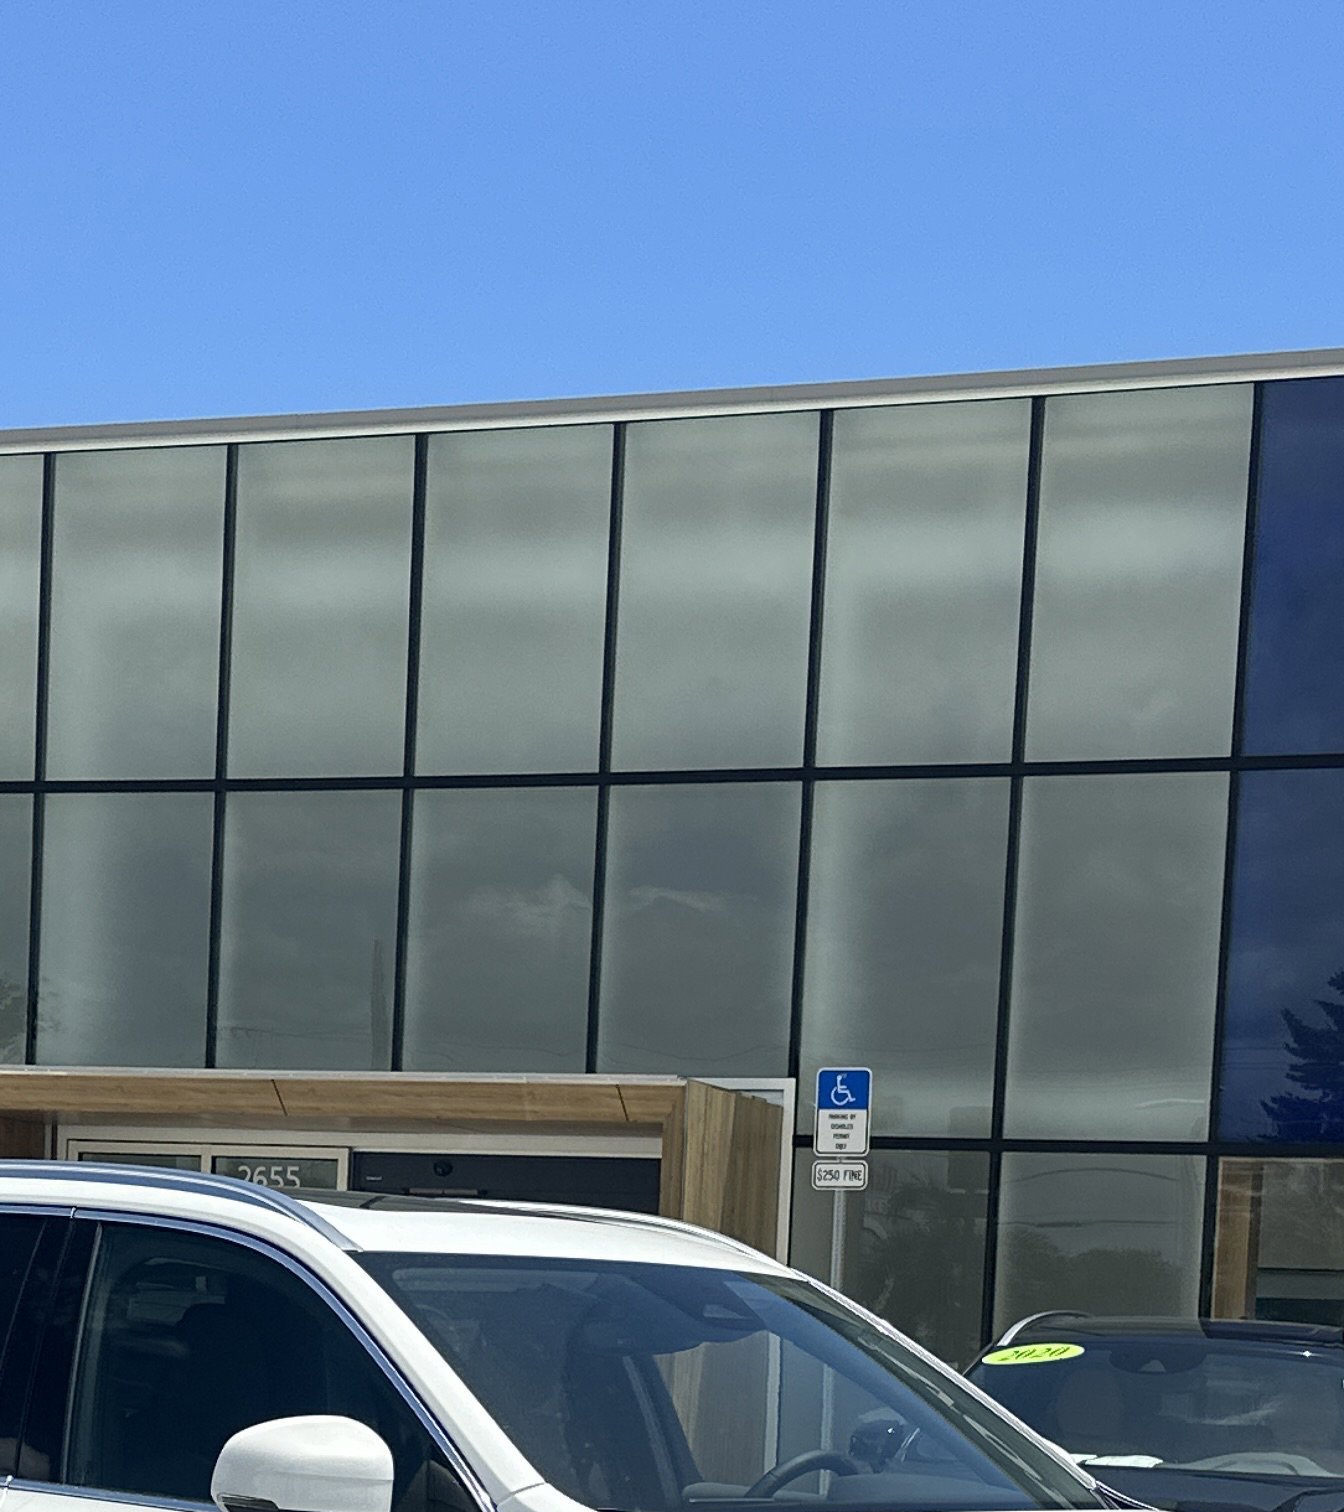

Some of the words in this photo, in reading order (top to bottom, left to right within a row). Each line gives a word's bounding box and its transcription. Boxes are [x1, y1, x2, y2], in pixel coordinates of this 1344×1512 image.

[238, 1165, 301, 1188] 2655
[816, 1167, 840, 1182] $250
[843, 1169, 862, 1181] FINE
[998, 1347, 1071, 1361] 2020
